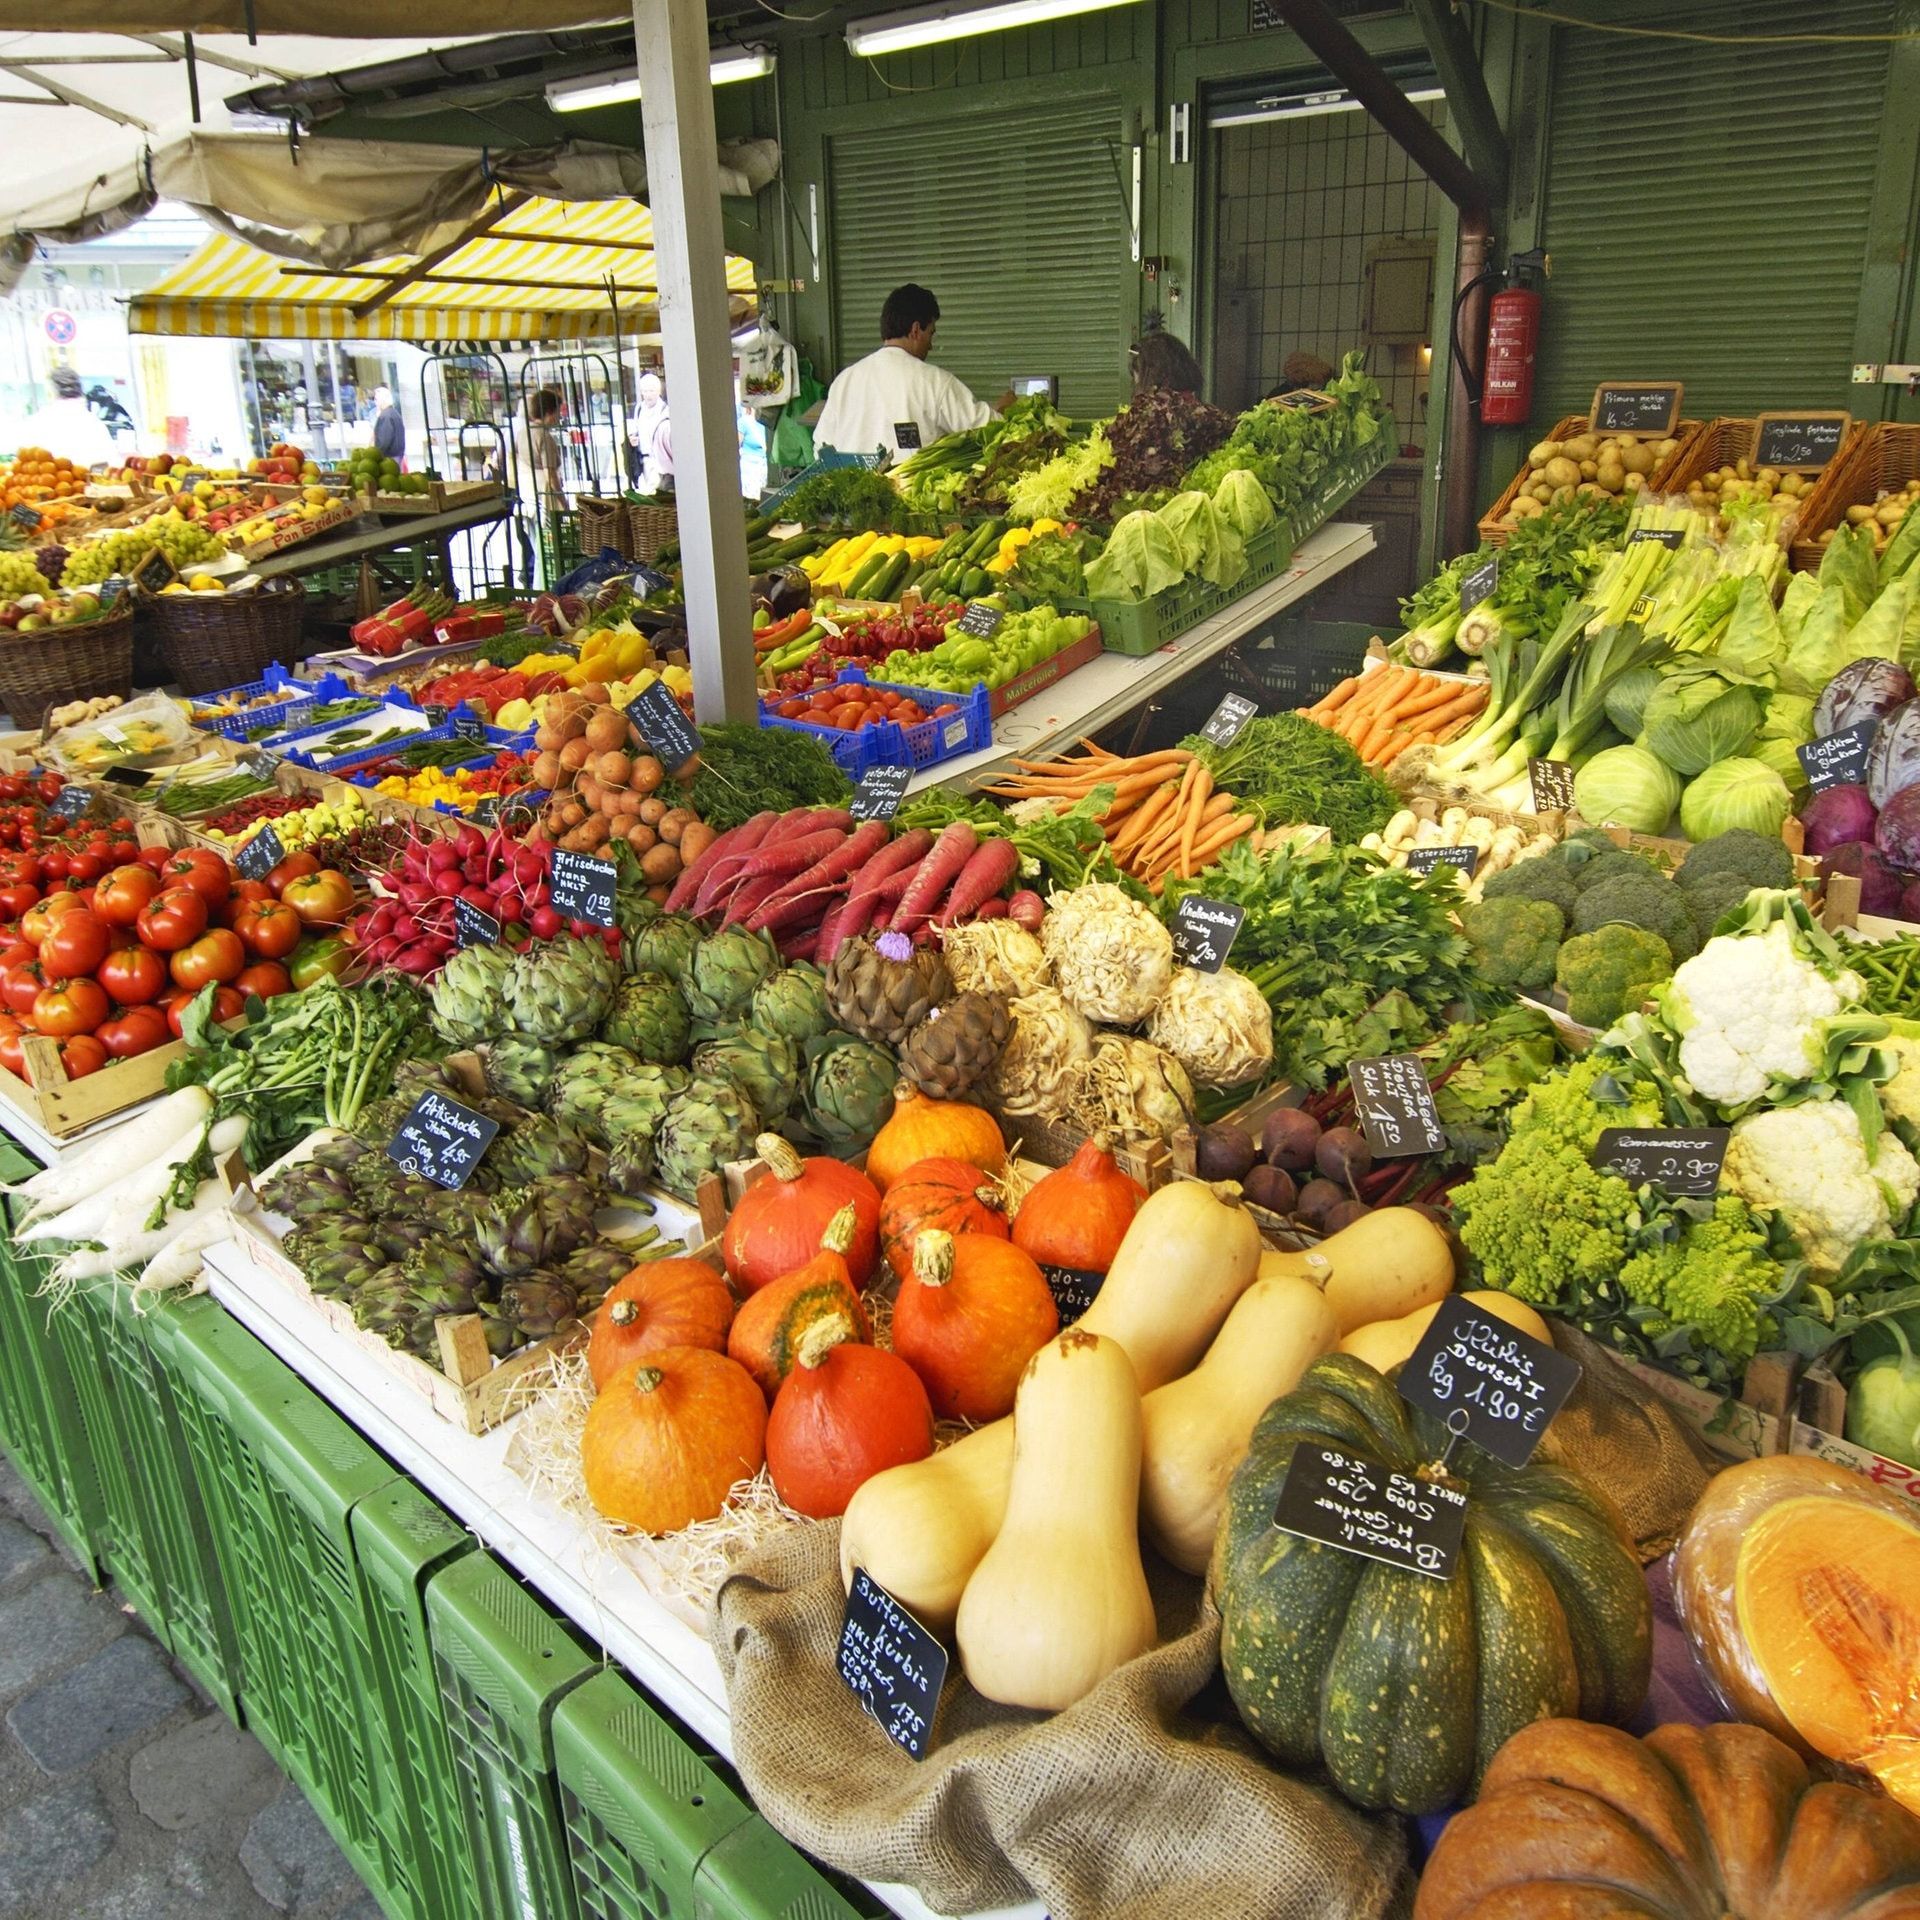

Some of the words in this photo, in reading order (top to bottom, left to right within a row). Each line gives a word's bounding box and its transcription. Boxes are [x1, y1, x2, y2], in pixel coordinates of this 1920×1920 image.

[271, 531, 299, 549] Pan
[1657, 1157, 1719, 1178] 2.90
[1446, 1343, 1523, 1393] Deutsch
